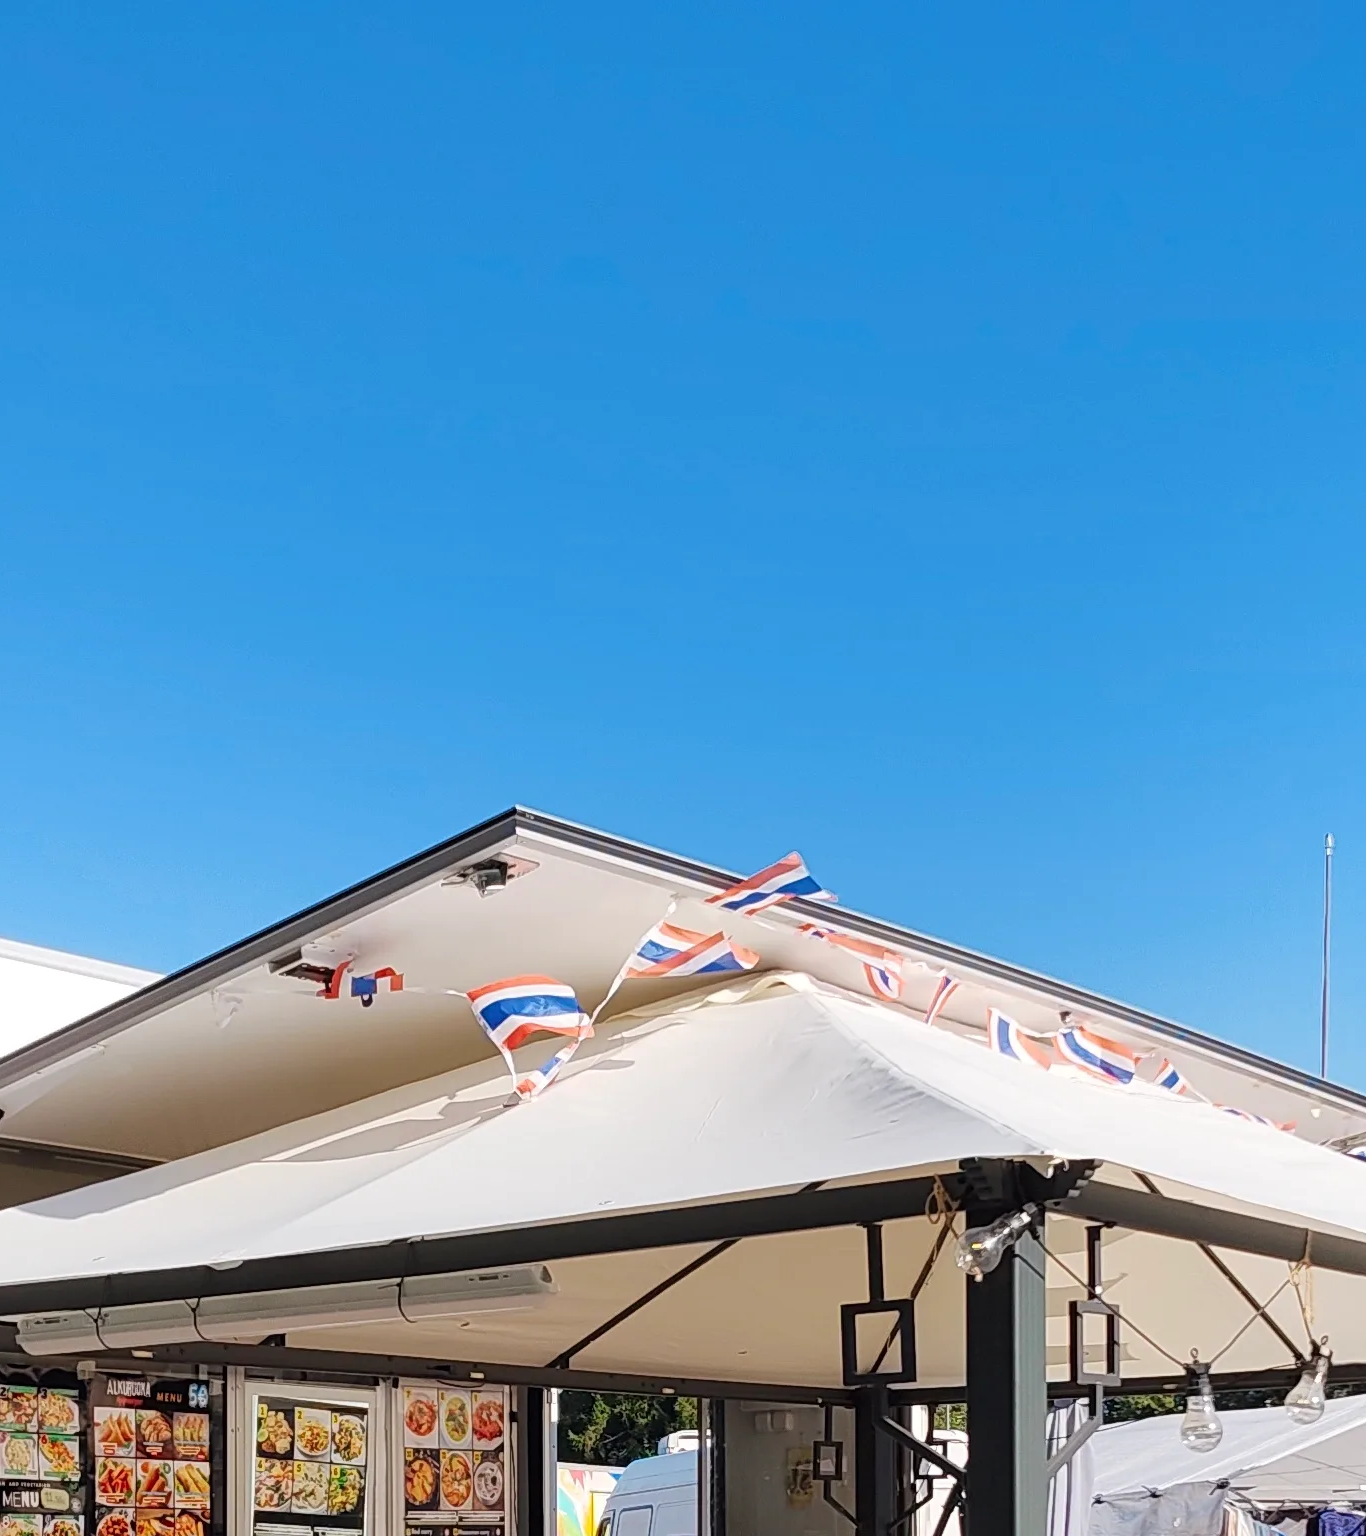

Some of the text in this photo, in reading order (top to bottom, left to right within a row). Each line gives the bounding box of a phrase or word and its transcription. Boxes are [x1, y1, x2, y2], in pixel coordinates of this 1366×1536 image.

[107, 1380, 183, 1403] ALKURUOKA MENU
[2, 1490, 40, 1508] MENU
